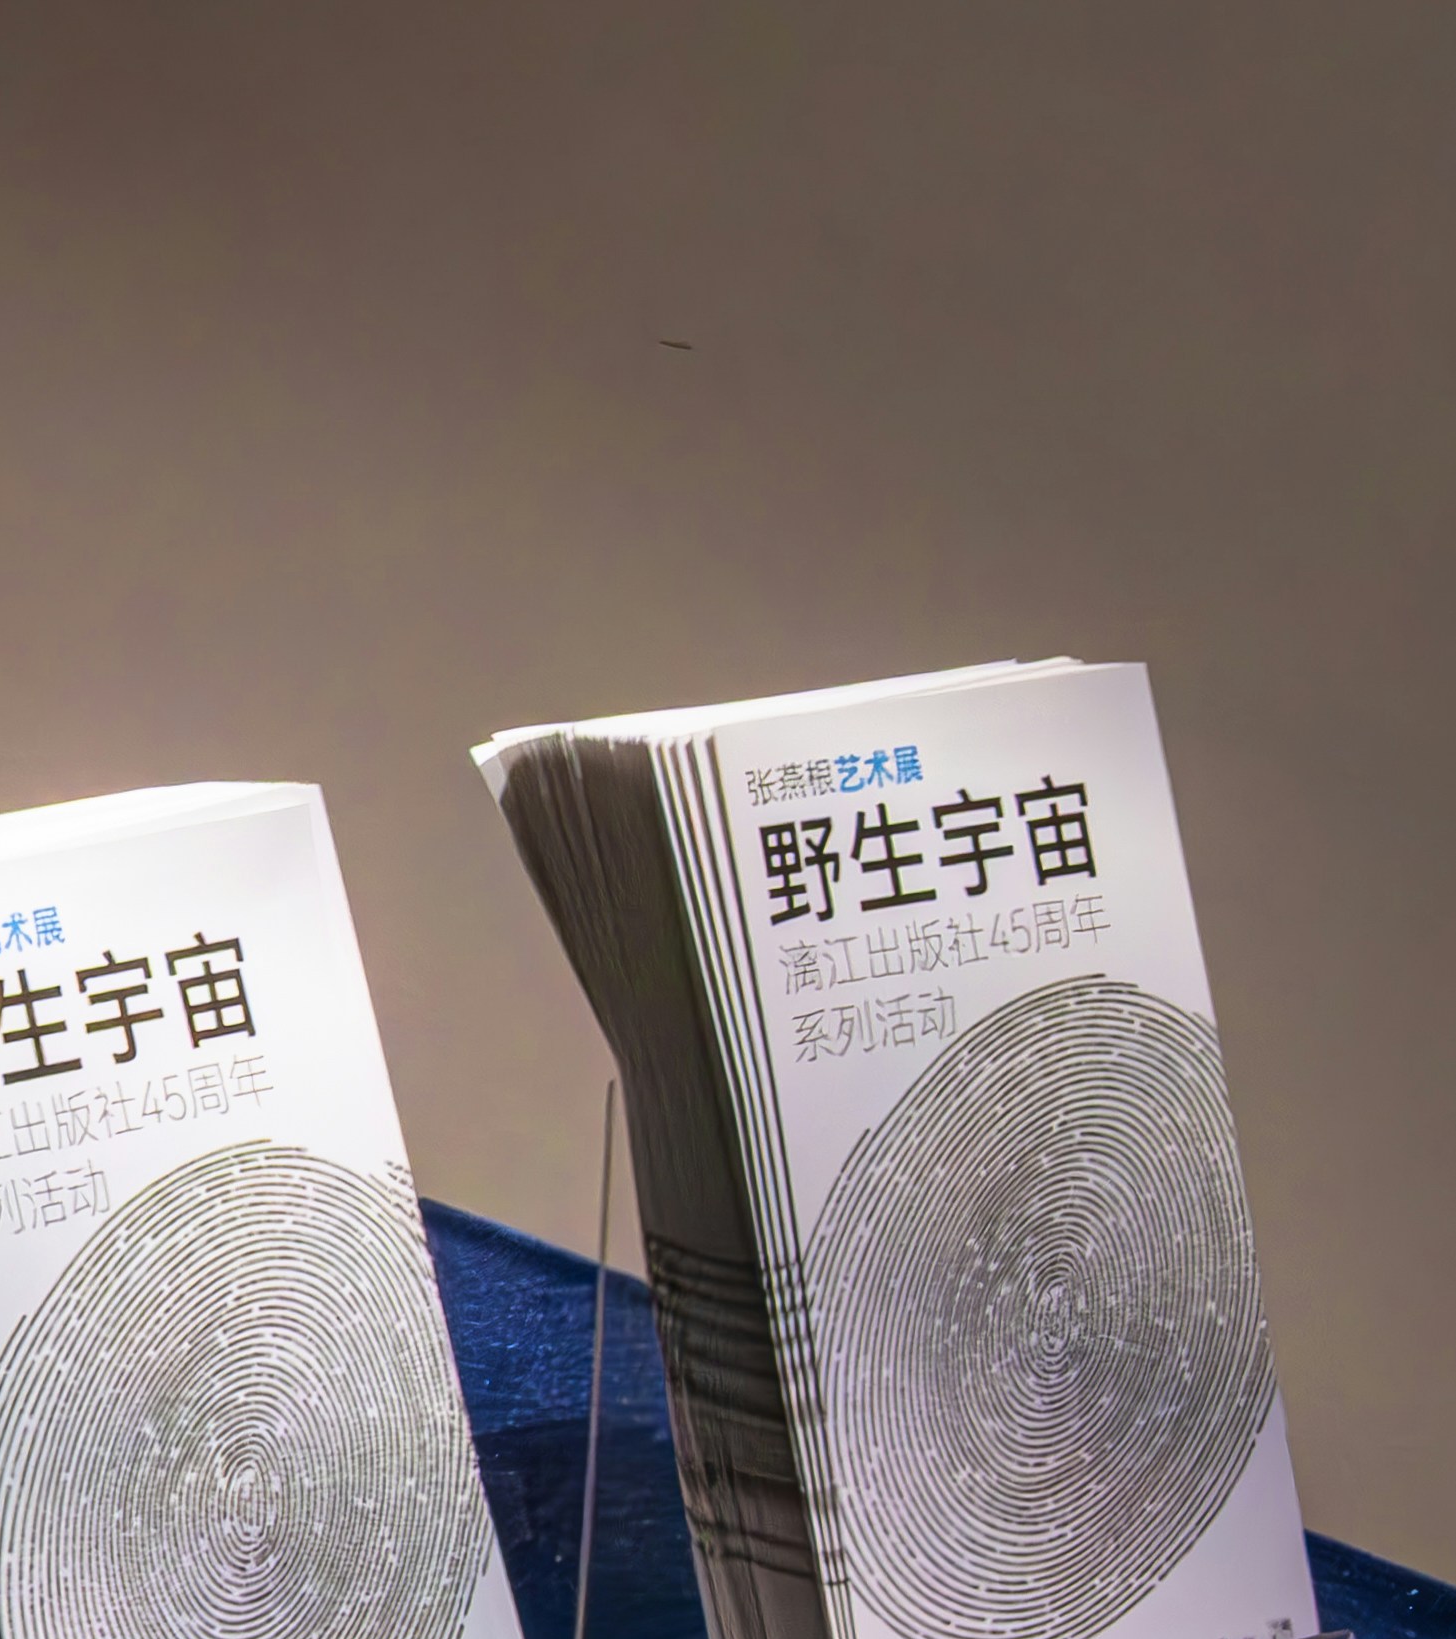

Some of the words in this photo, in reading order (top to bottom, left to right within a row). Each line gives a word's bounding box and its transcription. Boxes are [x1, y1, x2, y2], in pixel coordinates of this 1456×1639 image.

[745, 745, 925, 807] 张燕根艺术展
[758, 774, 1098, 927] 野生宇宙
[778, 894, 1111, 995] 漓江出版社45周年
[792, 987, 957, 1063] 系列活动
